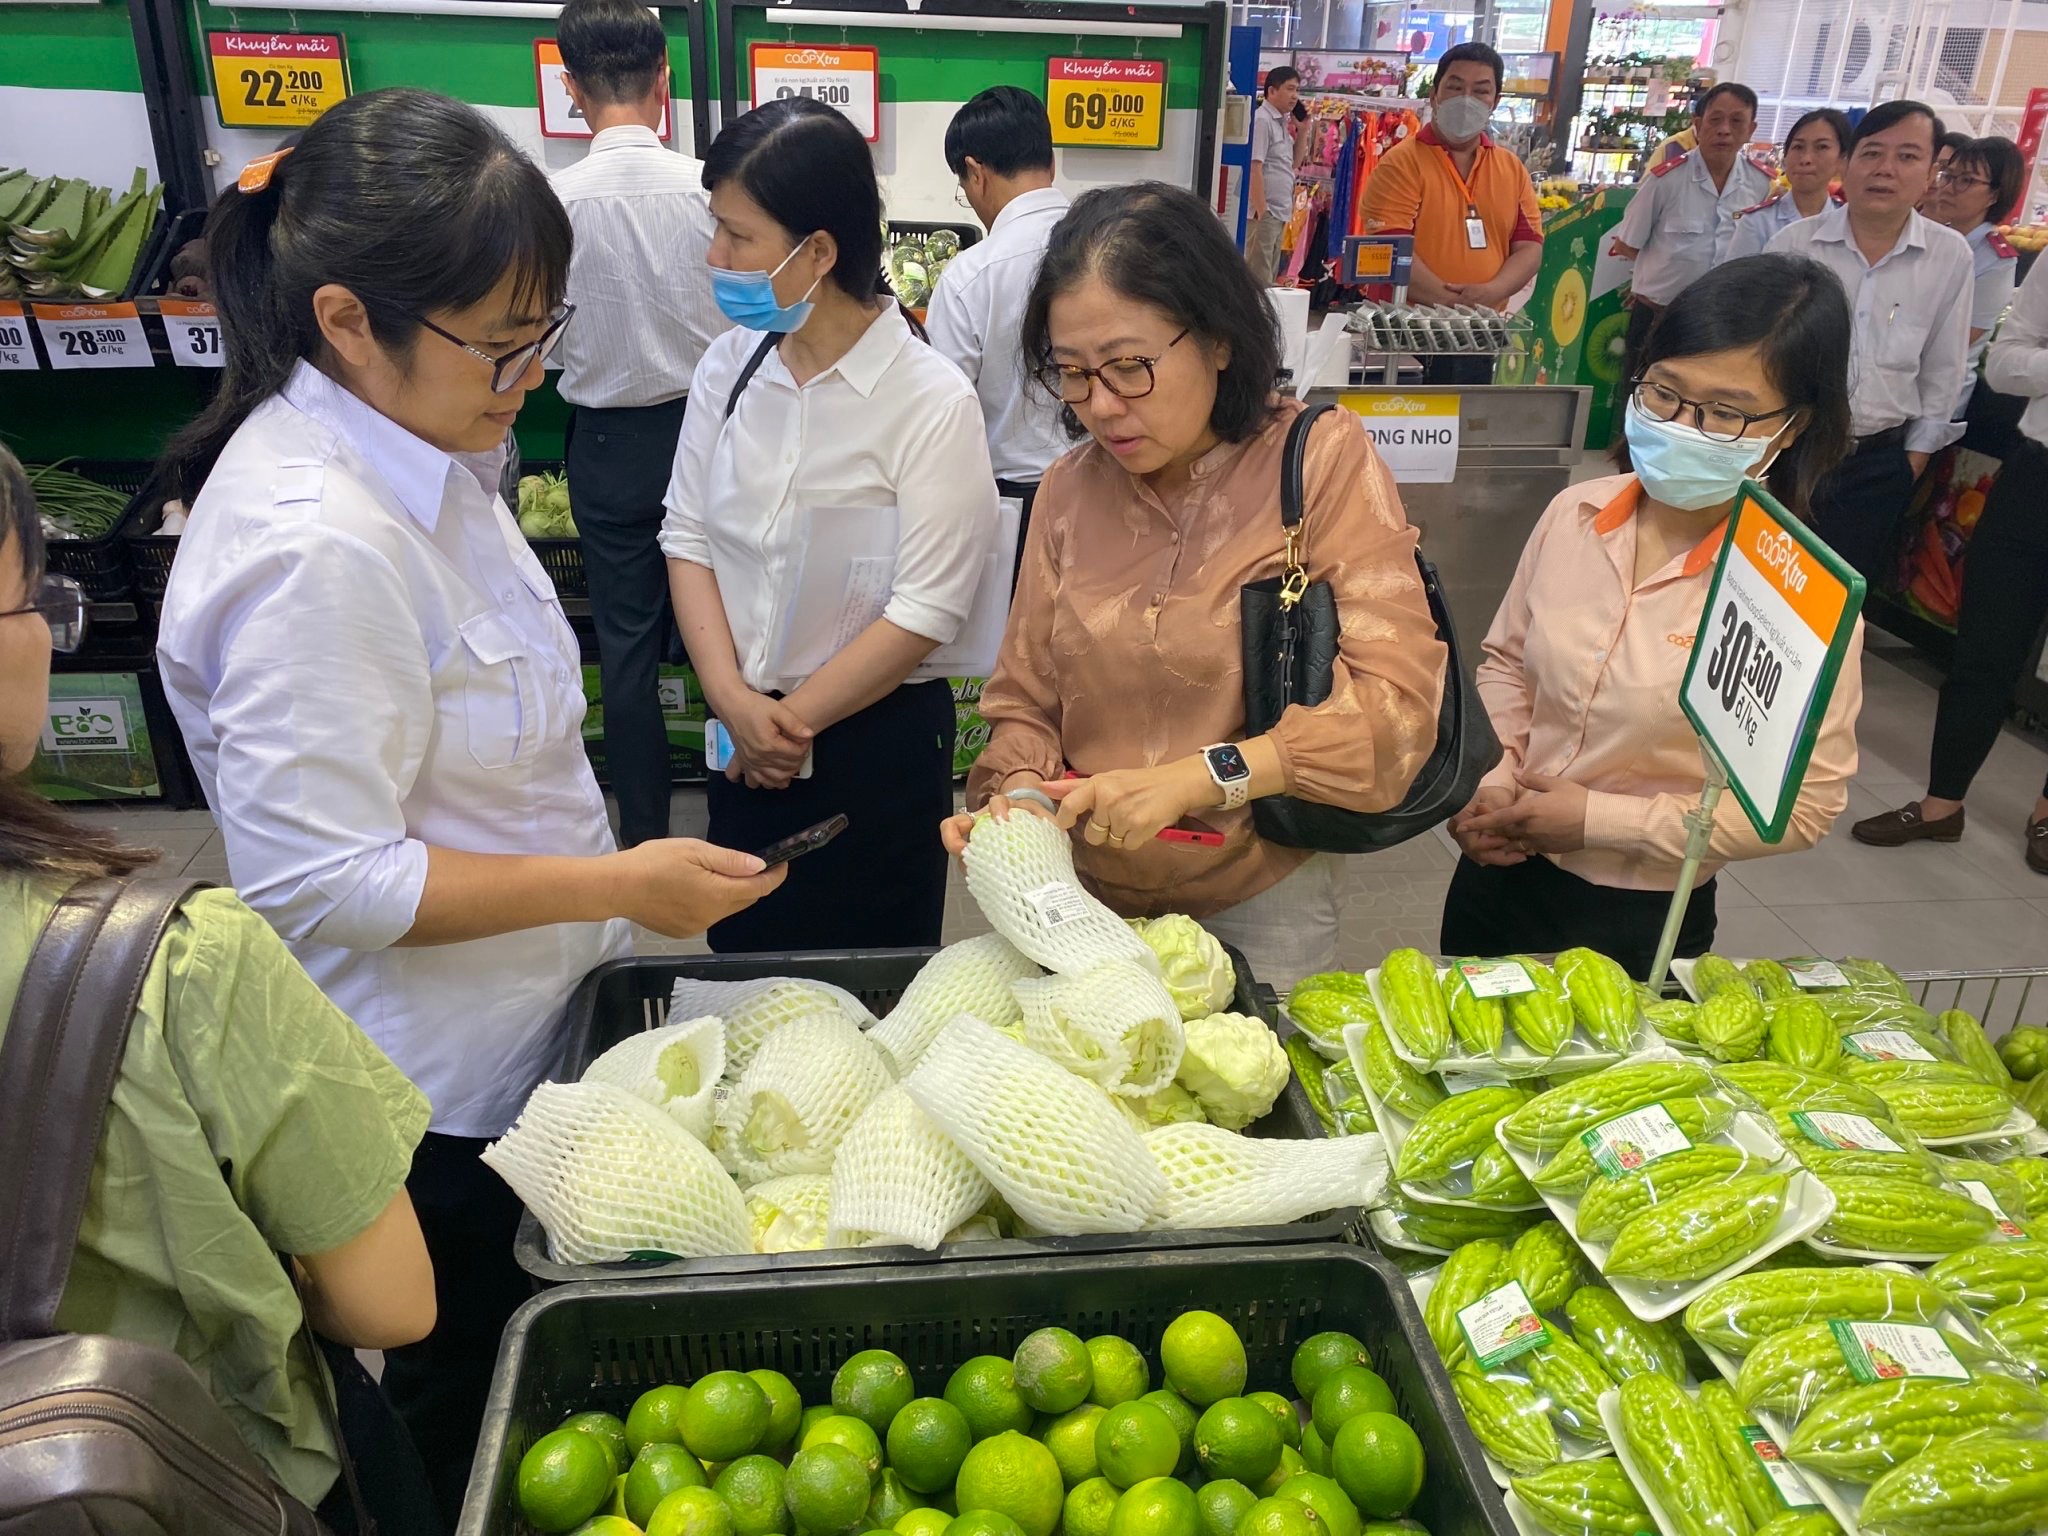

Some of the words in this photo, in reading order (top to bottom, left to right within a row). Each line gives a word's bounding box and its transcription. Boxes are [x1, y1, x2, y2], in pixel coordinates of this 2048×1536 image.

[225, 35, 292, 54] Khuyến
[296, 38, 330, 52] mãi
[1063, 60, 1121, 78] Khuyến
[1125, 64, 1154, 77] mãi
[186, 304, 216, 314] COOP
[0, 327, 23, 346] 00
[1366, 429, 1404, 445] ONG
[1411, 429, 1452, 445] NHO
[1707, 601, 1783, 713] 30.500
